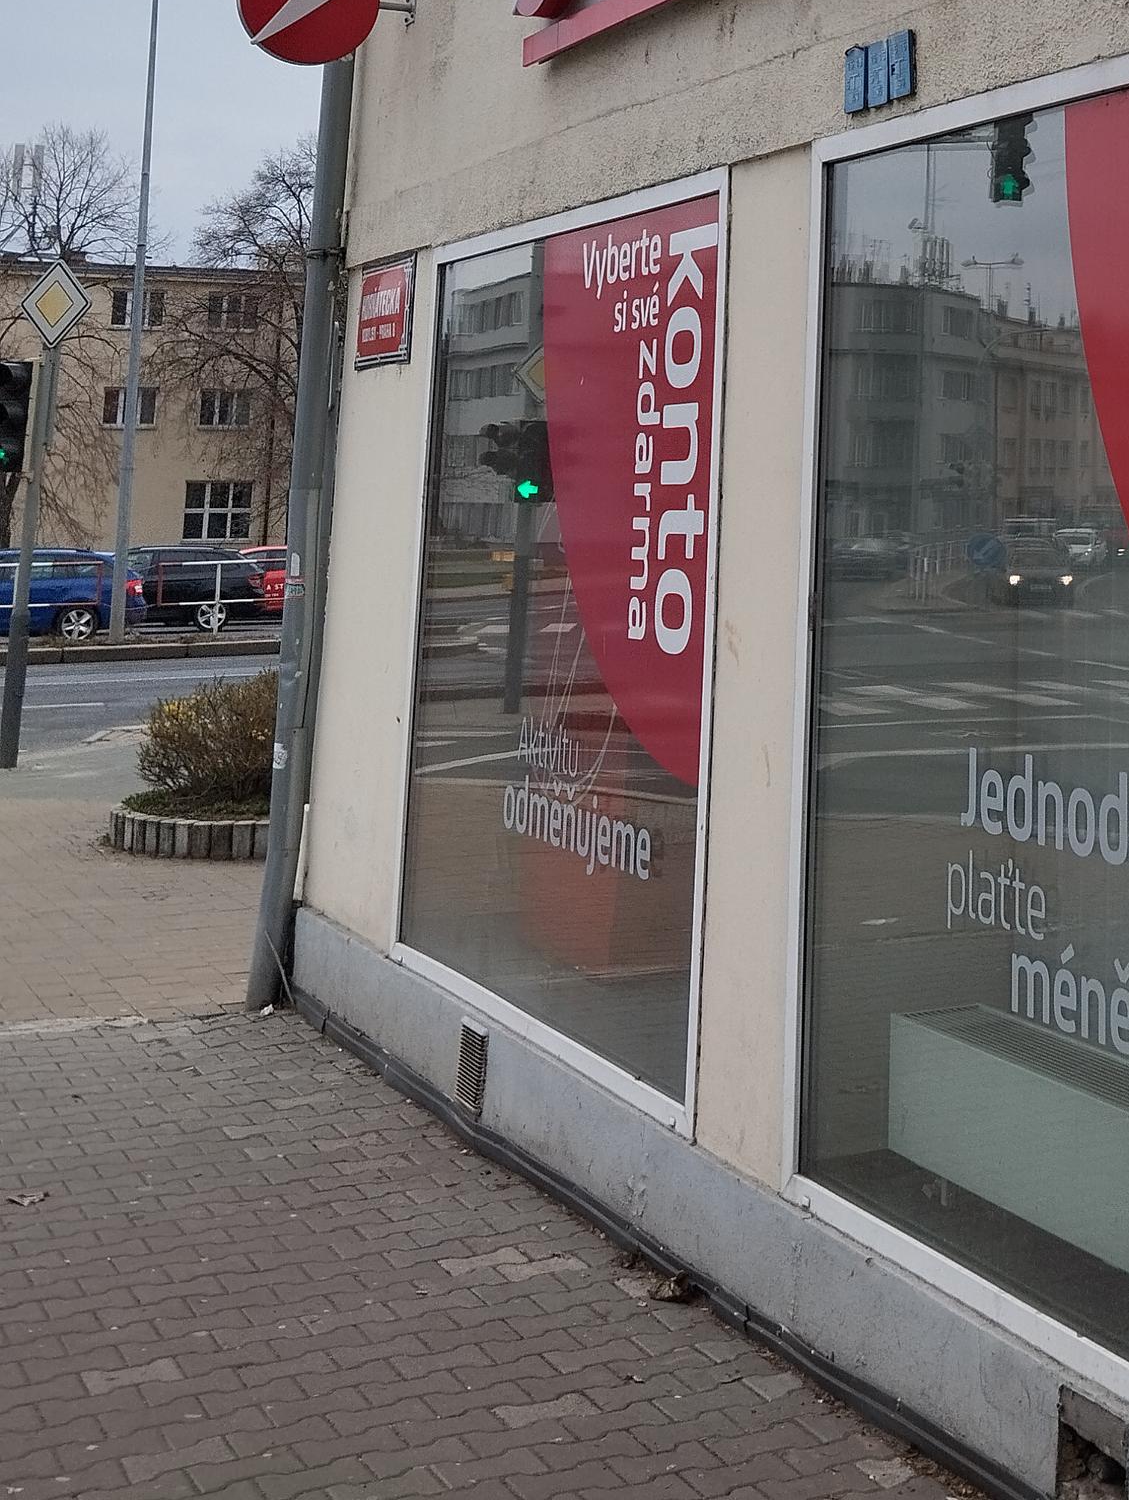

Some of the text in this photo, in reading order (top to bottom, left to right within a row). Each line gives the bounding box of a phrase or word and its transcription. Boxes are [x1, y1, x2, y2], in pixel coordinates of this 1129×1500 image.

[361, 281, 402, 321] ŇÁTECKÁ
[583, 229, 662, 300] Vyberte
[614, 282, 661, 332] si své
[654, 222, 718, 655] konto
[628, 339, 661, 641] zdarma
[517, 716, 580, 778] Aktivitu
[503, 774, 651, 881] odměňujeme
[947, 850, 1046, 941] plaťte
